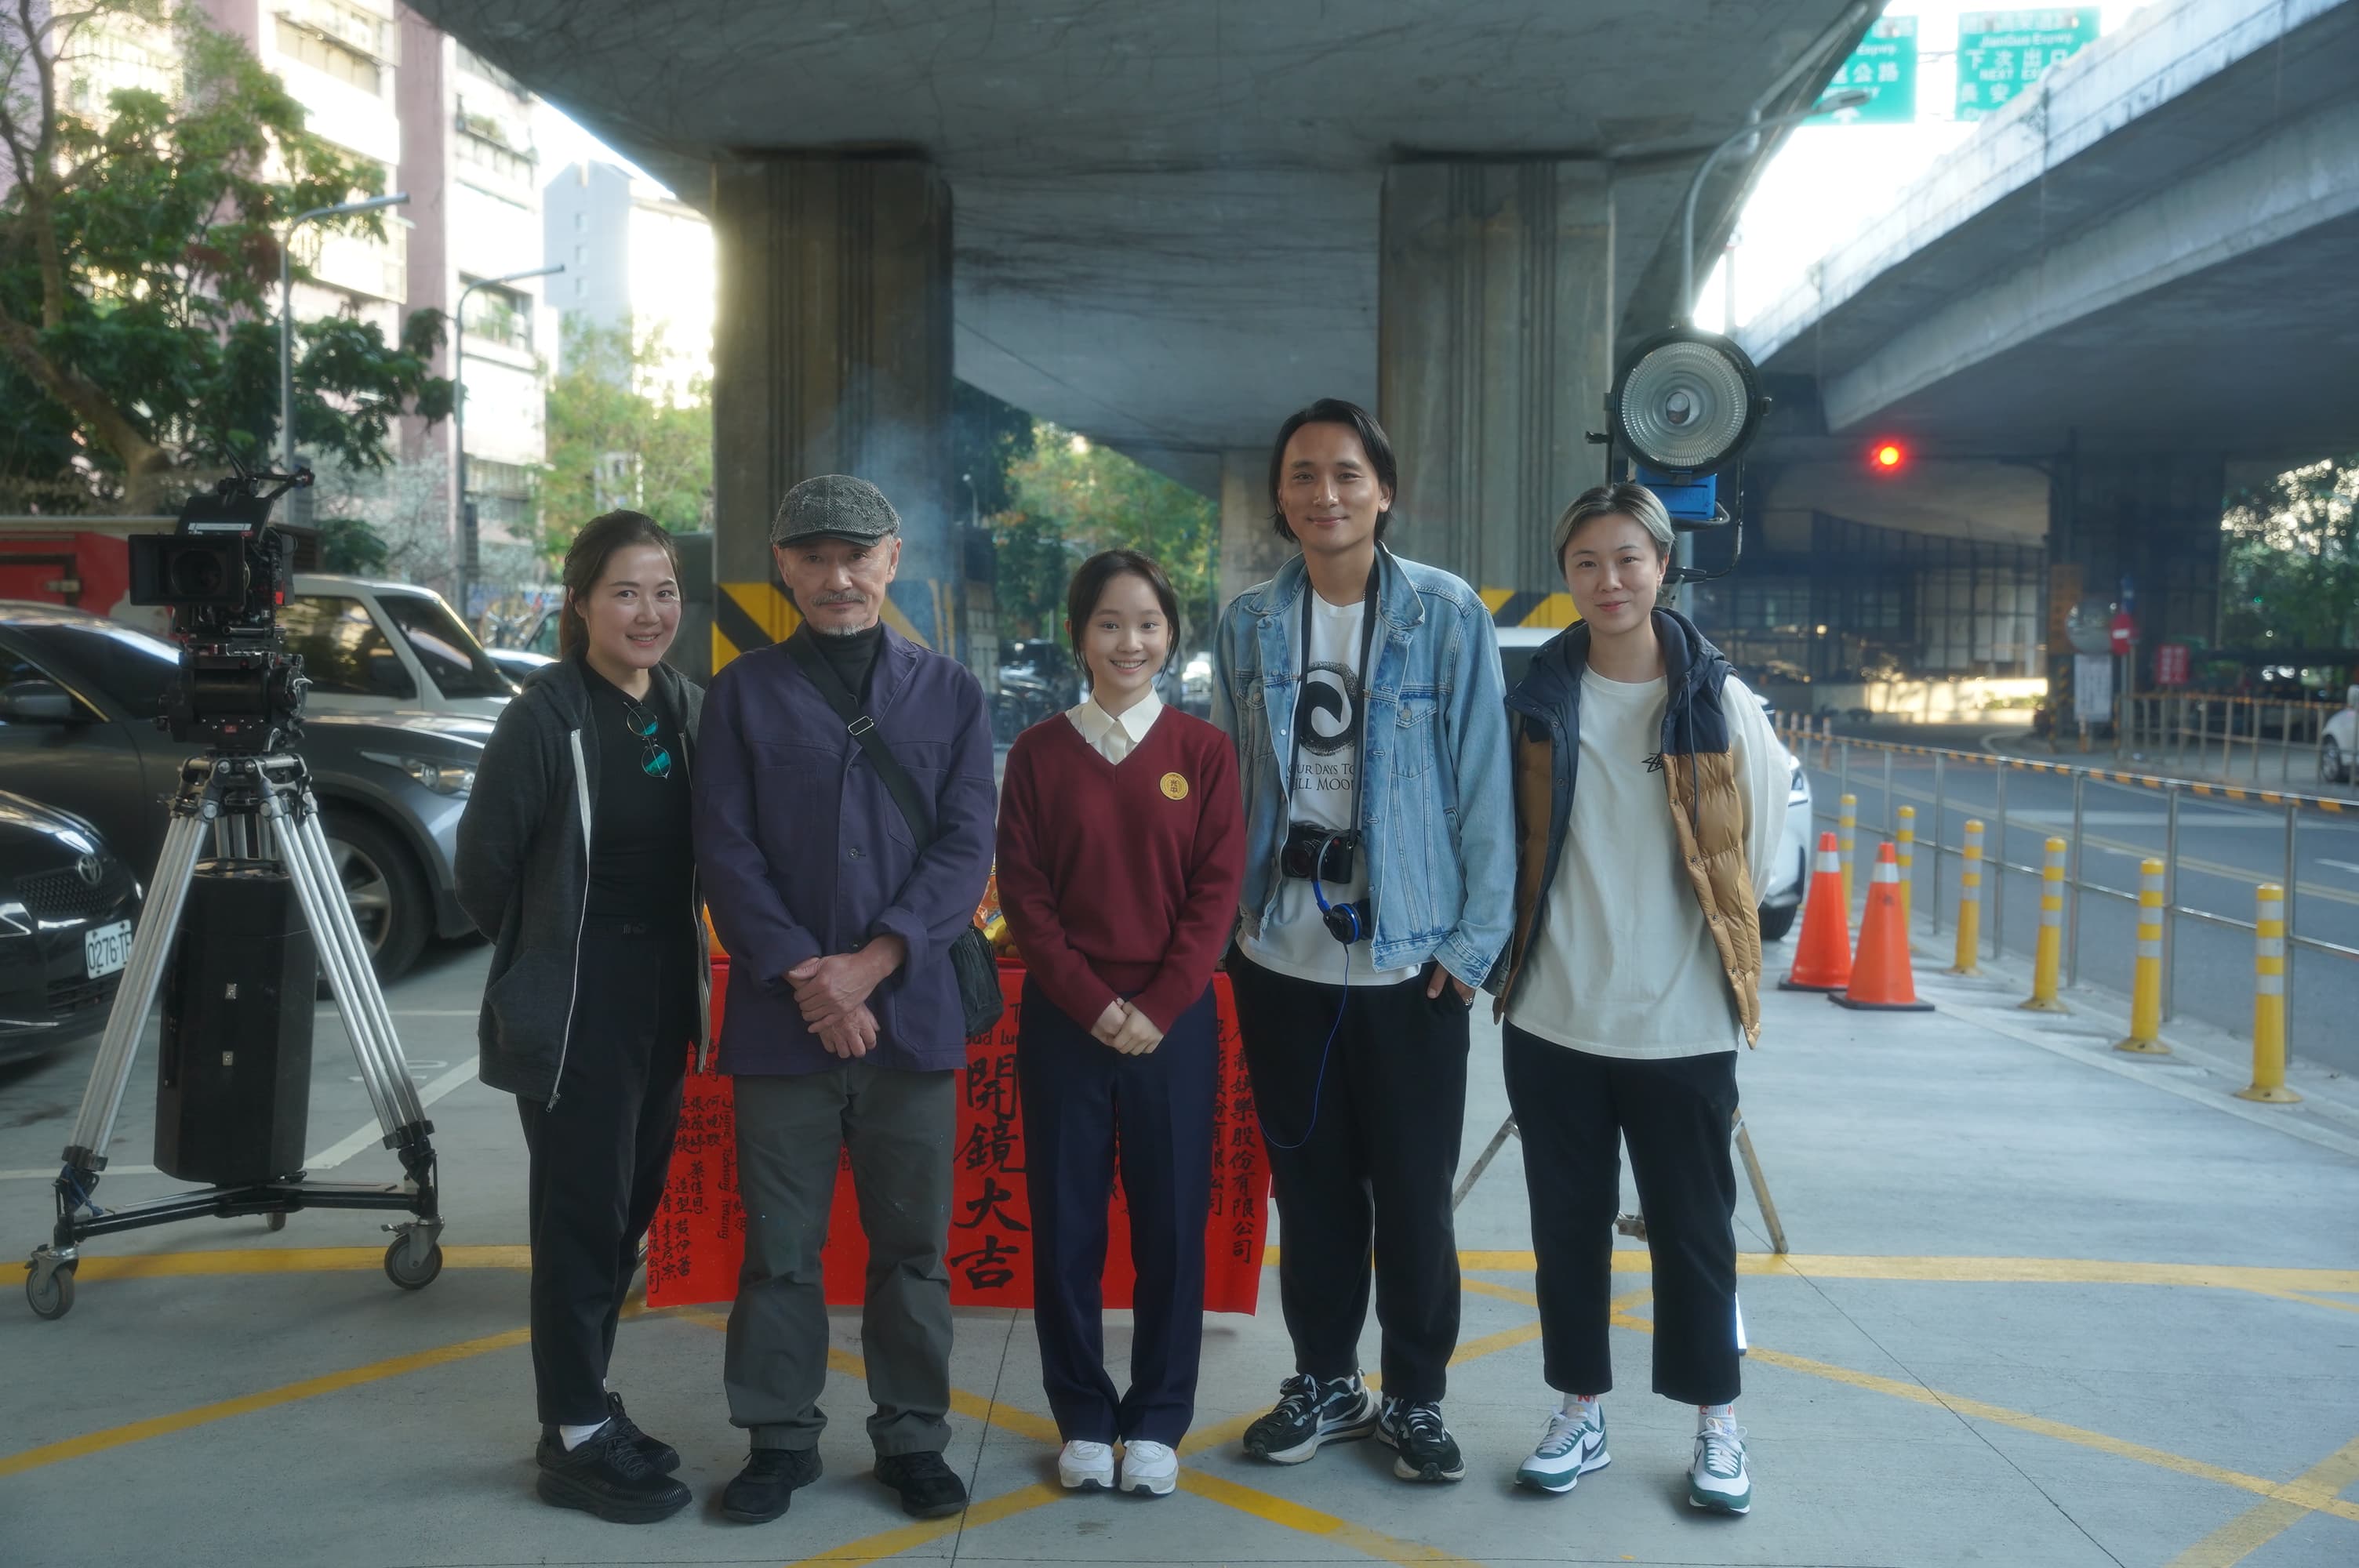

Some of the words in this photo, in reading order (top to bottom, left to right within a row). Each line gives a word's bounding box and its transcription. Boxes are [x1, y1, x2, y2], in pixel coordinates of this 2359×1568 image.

[1965, 48, 2068, 70] 下次出口
[1979, 68, 2014, 81] NEXT
[1315, 763, 1338, 775] DAYS
[1317, 777, 1354, 790] MOO
[949, 1053, 1030, 1291] 開鏡大吉
[674, 1175, 692, 1215] 造型
